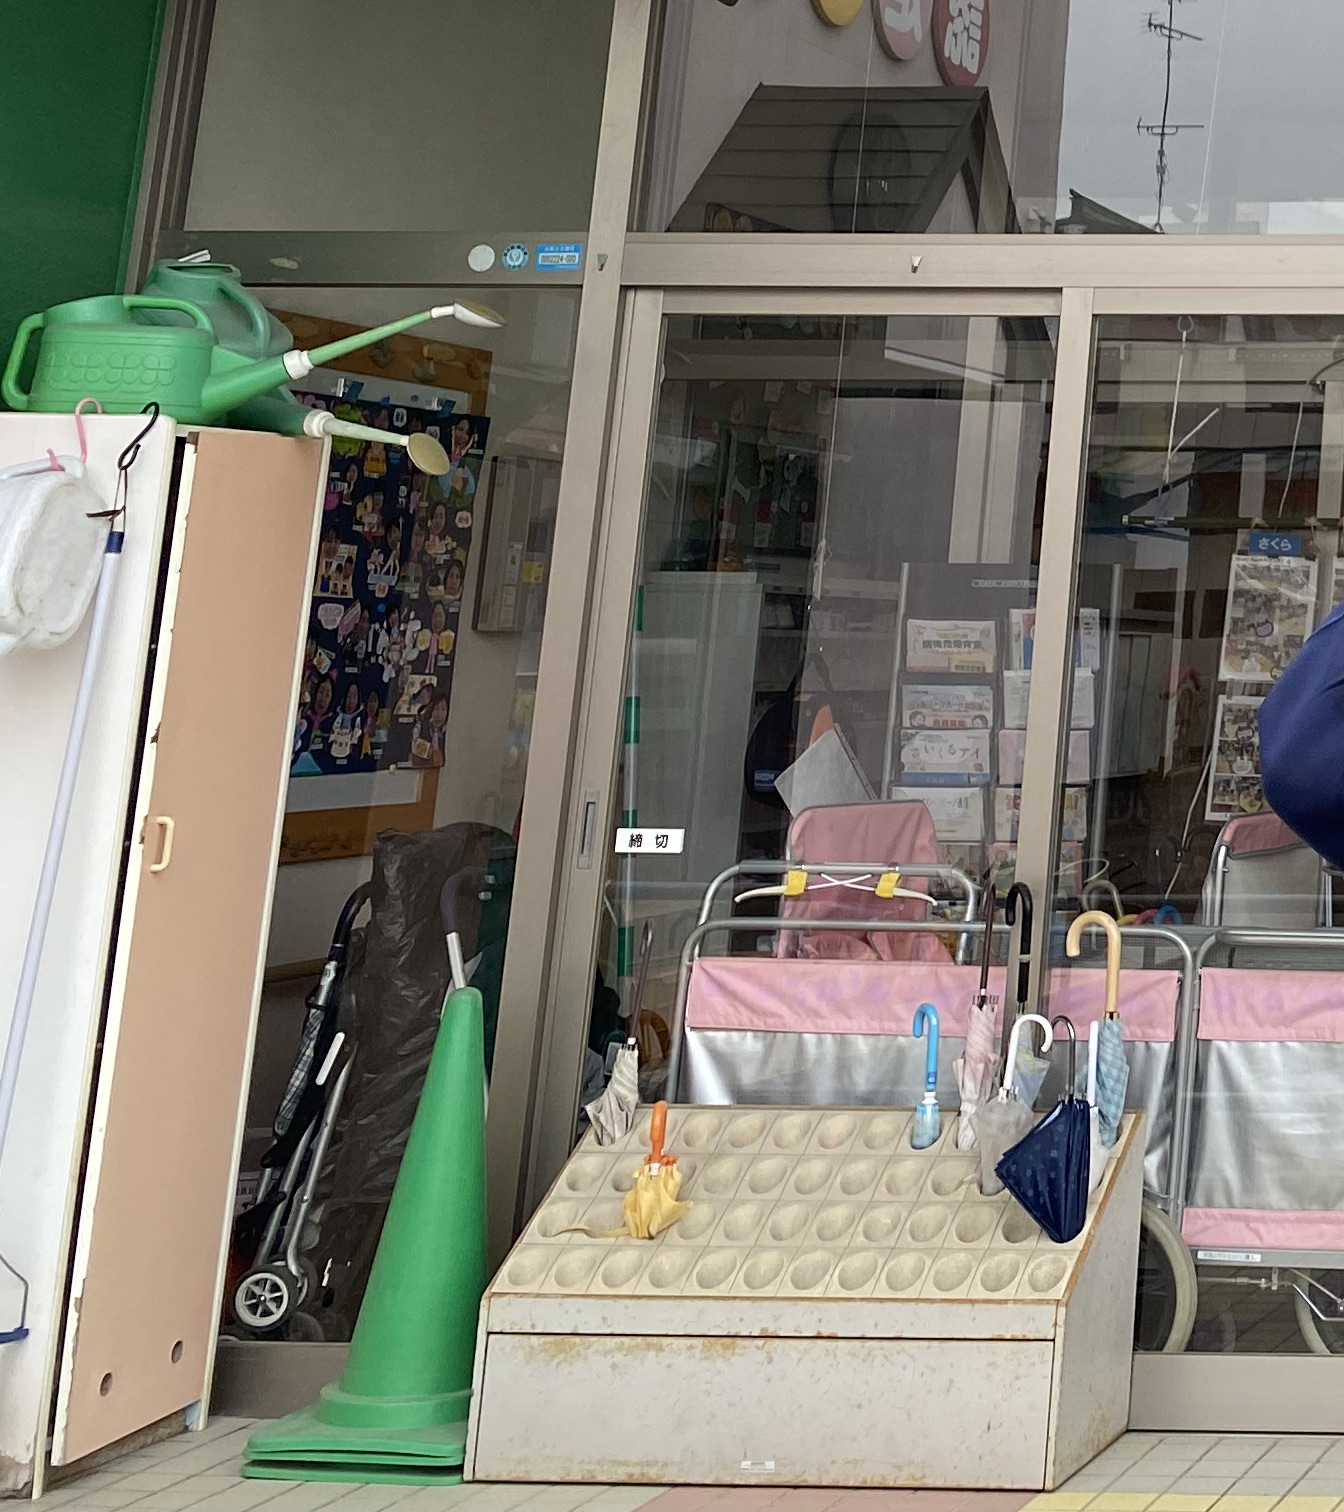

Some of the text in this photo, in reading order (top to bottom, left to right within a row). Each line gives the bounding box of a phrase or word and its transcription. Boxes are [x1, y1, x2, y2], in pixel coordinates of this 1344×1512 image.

[1258, 536, 1292, 552] さくら
[627, 832, 669, 849] 締切
